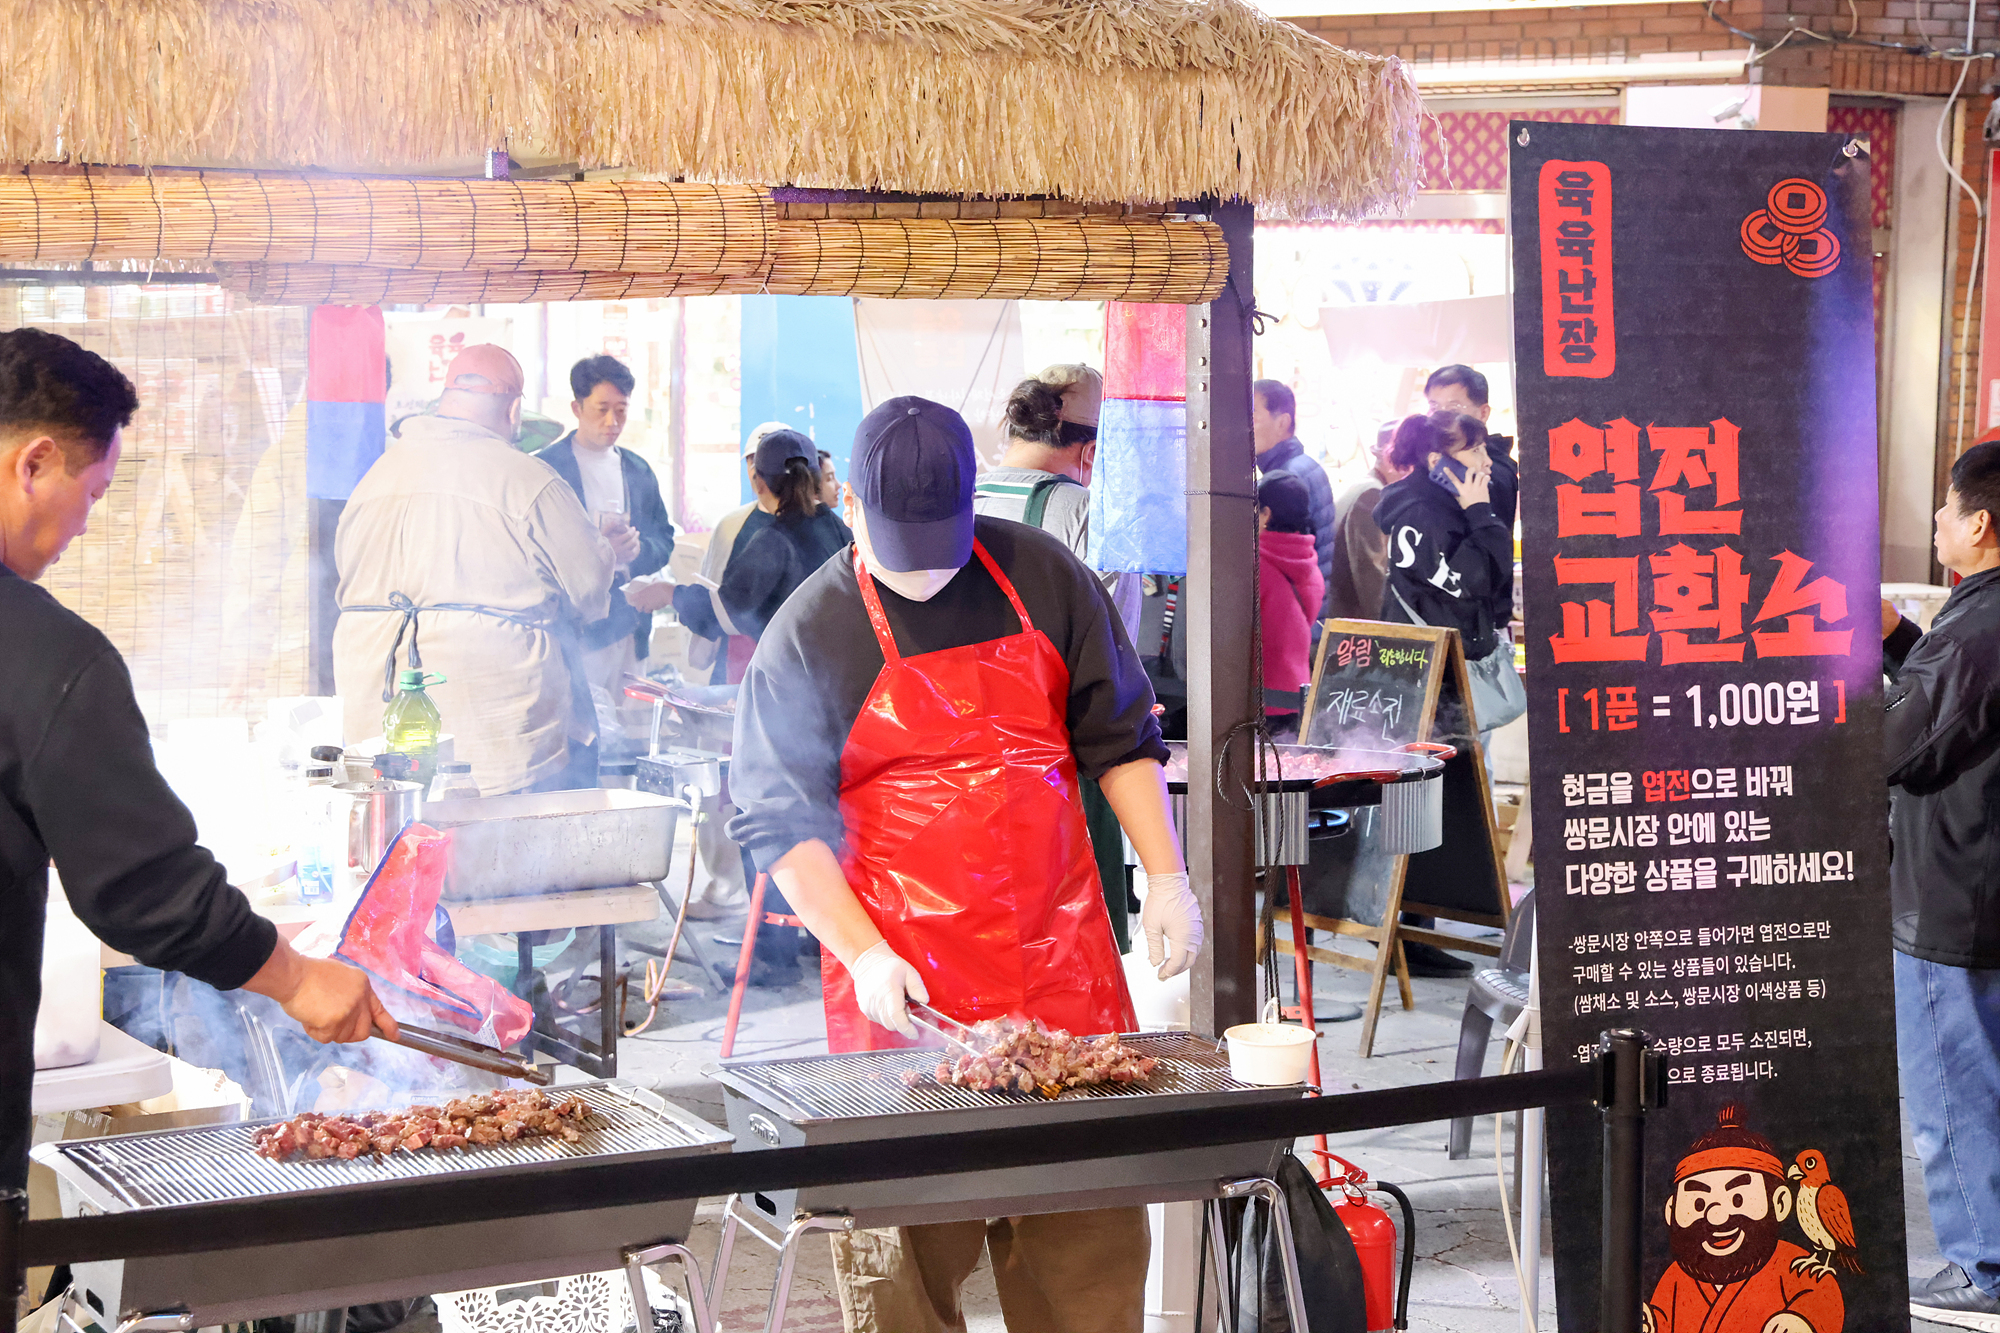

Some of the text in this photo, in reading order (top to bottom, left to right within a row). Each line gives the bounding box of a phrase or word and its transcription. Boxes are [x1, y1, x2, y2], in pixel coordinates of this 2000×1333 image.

[1555, 170, 1598, 364] 육육난장
[1548, 415, 1744, 538] 엽전
[1549, 541, 1854, 666] 교환소
[1336, 635, 1429, 669] 알림 죄송합니다
[1326, 687, 1403, 744] 재료소진
[1583, 687, 1638, 731] 1푼
[1685, 681, 1820, 729] 1,000원
[1562, 765, 1793, 806] 현금을 엽전으로 바꿔
[1563, 810, 1771, 850] 쌍문시장 안에 있는
[1565, 850, 1855, 895] 다양한 상품을 구매하세요!
[1568, 920, 1832, 954] -쌍문시장 안쪽으로 들어가면 엽전으로만
[1573, 951, 1796, 984] 구매할 수 있는 상품들이 있습니다.
[1574, 978, 1826, 1016] (쌈채소 및 소스, 쌍문시장 이색상품 등)
[1653, 1036, 1712, 1056] 수량으로
[1716, 1033, 1745, 1051] 모두
[1749, 1027, 1812, 1049] 소진되면,
[1700, 1060, 1778, 1083] 종료됩니다.
